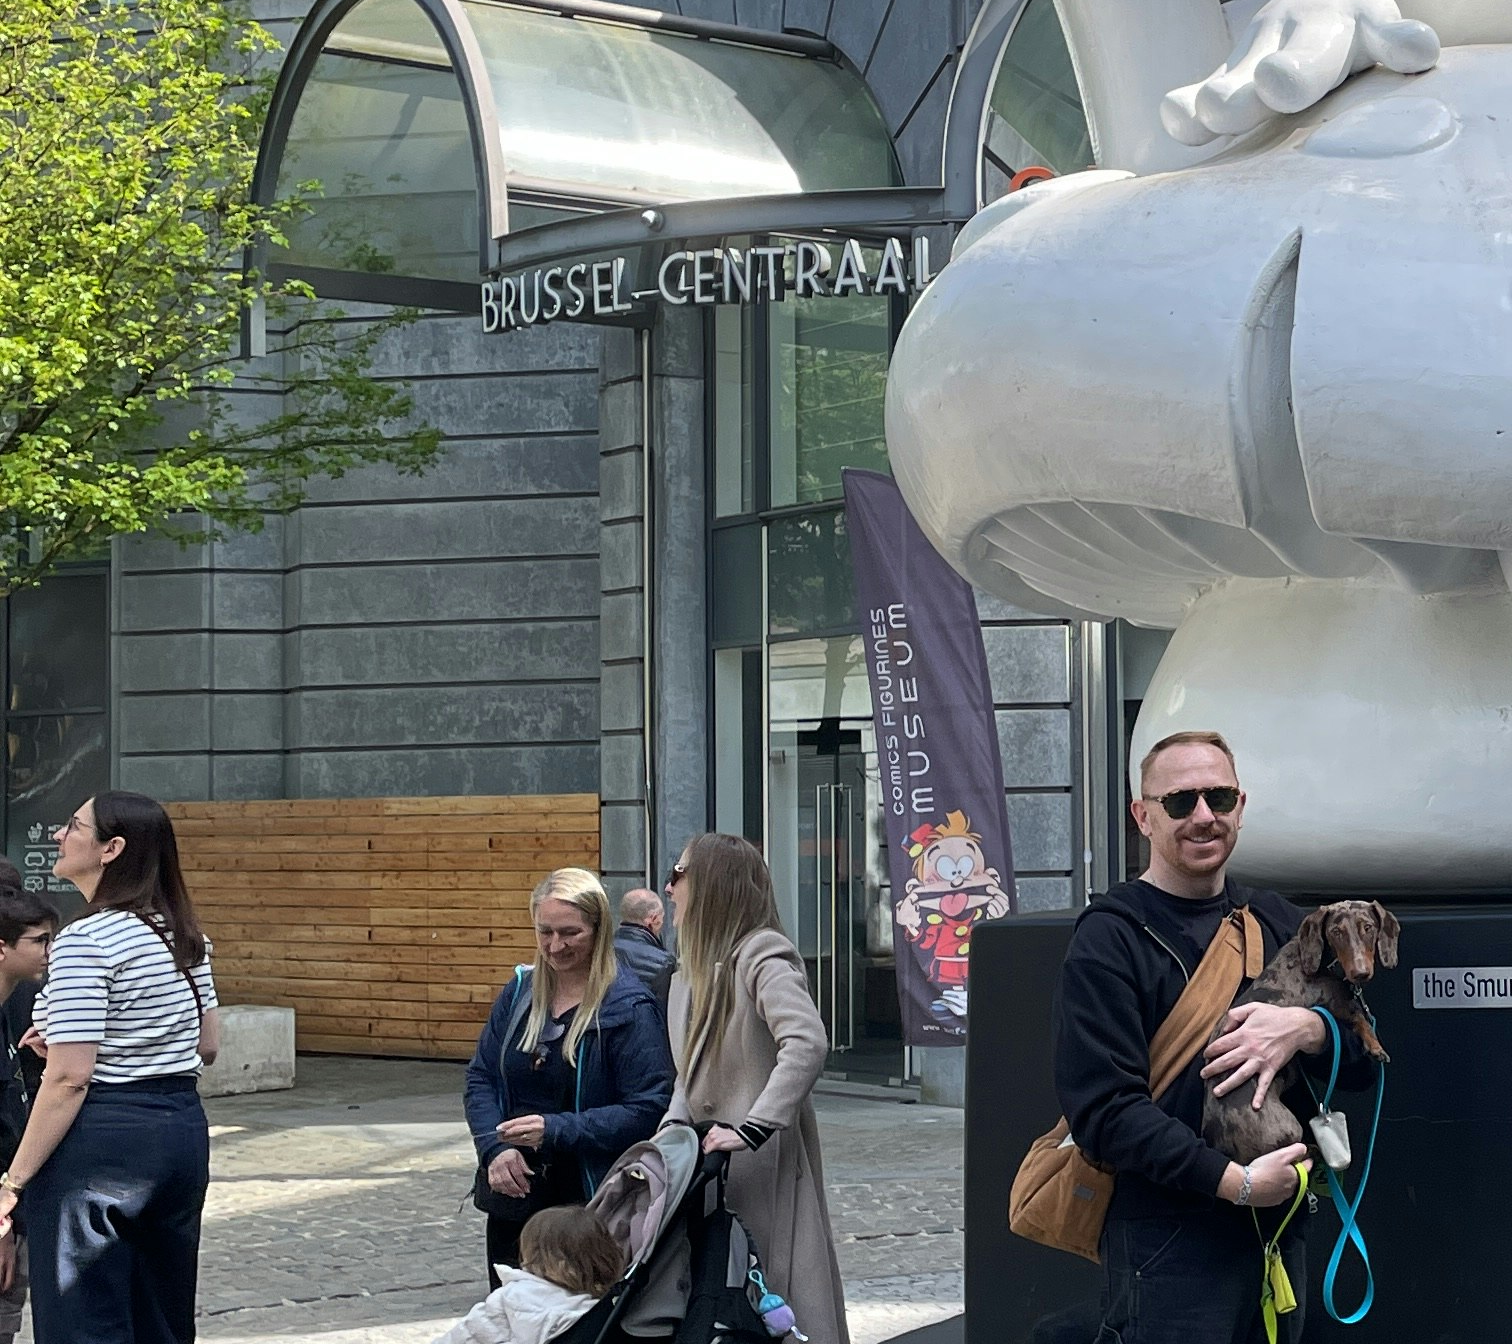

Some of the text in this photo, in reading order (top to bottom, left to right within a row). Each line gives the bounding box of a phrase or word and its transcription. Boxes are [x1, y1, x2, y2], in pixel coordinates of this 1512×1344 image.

[482, 236, 931, 333] BRUSSEL CENTRAAL
[1423, 972, 1455, 998] the
